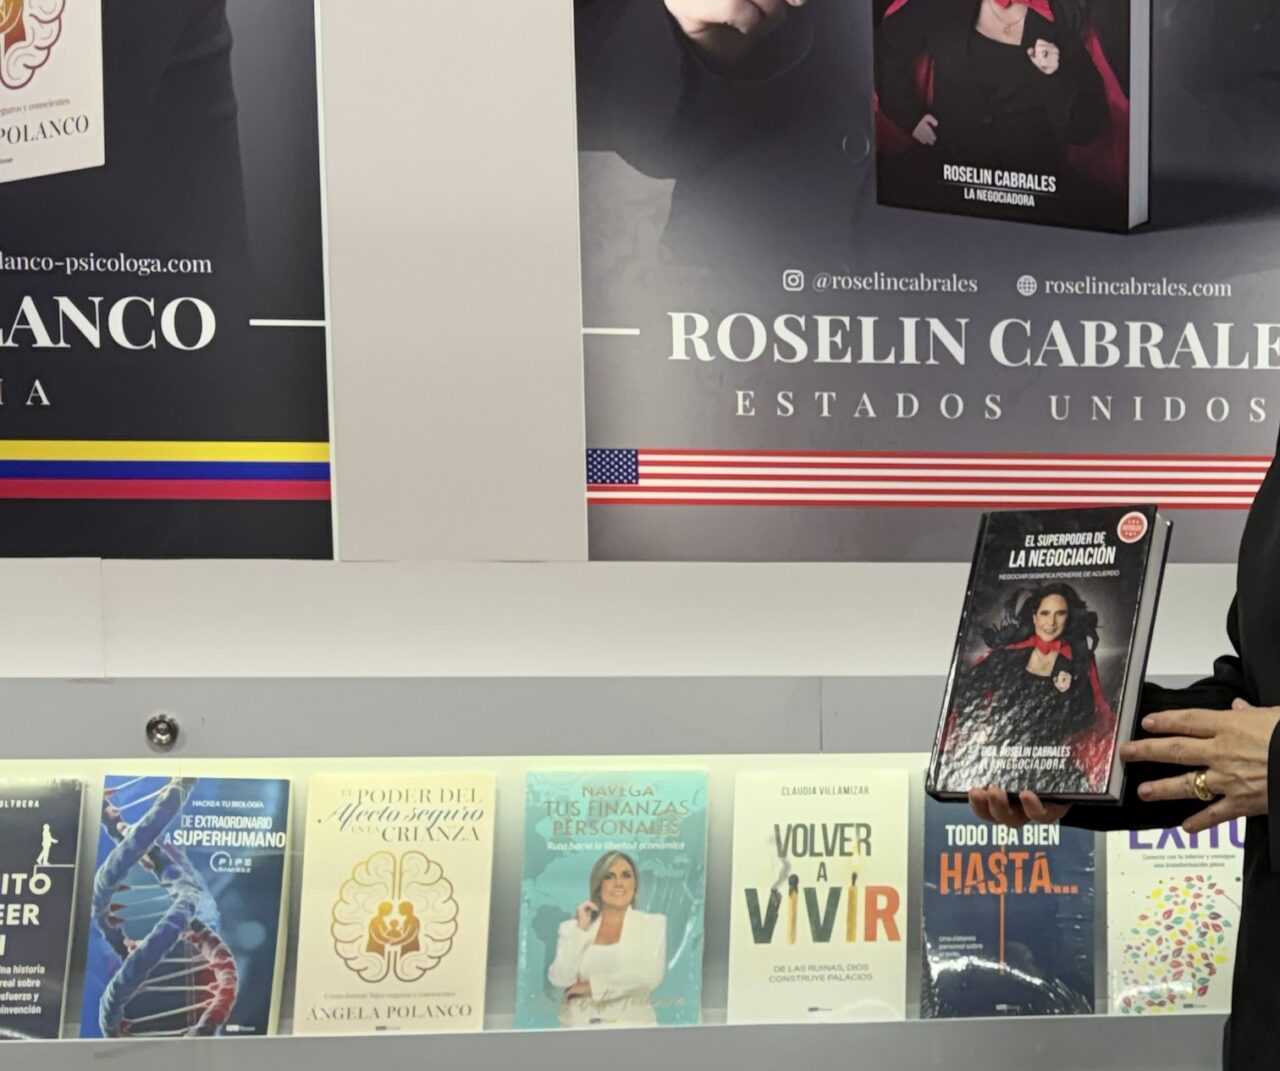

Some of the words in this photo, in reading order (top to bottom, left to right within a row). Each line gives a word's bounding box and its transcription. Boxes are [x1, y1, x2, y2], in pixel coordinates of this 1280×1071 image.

[943, 164, 992, 187] ROSELIN
[994, 169, 1057, 193] CABRALES
[964, 187, 975, 201] LA
[976, 188, 1035, 207] NEGOCIADORA
[813, 271, 978, 295] @roselincabrales
[1044, 275, 1232, 298] roselincabrales.com
[0, 295, 216, 351] ANCO
[667, 311, 966, 366] ROSELIN
[735, 390, 1002, 421] ESTADOS
[1049, 395, 1267, 423] UNIDOS
[1025, 535, 1036, 547] EL
[1037, 532, 1092, 547] SUPERPODER
[1094, 531, 1107, 544] DE
[1009, 550, 1026, 568] LA
[1028, 544, 1117, 568] NEGOCIACIÓN
[1032, 745, 1071, 757] CABRALES
[357, 788, 431, 803] PODER
[440, 788, 484, 803] DEL
[582, 784, 655, 797] NAVEGA
[781, 786, 817, 796] CLAUDIA
[819, 785, 870, 795] VILLAMIZAR
[544, 800, 581, 817] TUS
[588, 799, 690, 816] FINANZAS
[181, 815, 194, 828] DE
[194, 815, 273, 829] EXTRAORDINARIO
[404, 807, 484, 830] seguro
[382, 826, 480, 842] CRIANZA
[553, 819, 680, 836] PERSONALES
[945, 824, 989, 846] TODO
[992, 824, 1019, 846] IBA
[1022, 824, 1060, 846] BIEN
[163, 832, 172, 845] A
[173, 830, 286, 847] SUPERHUMANO
[774, 823, 872, 858] VOLVER
[816, 861, 828, 882] A
[744, 874, 902, 945] VIVIR
[13, 964, 45, 974] historia
[773, 965, 785, 973] DE
[788, 965, 806, 973] LAS
[846, 964, 869, 972] DIOS
[17, 978, 41, 987] sobre
[768, 974, 825, 983] CONSTRUYE
[827, 973, 873, 982] PALACIOS
[33, 993, 39, 1003] y
[386, 1004, 472, 1019] POLANCO
